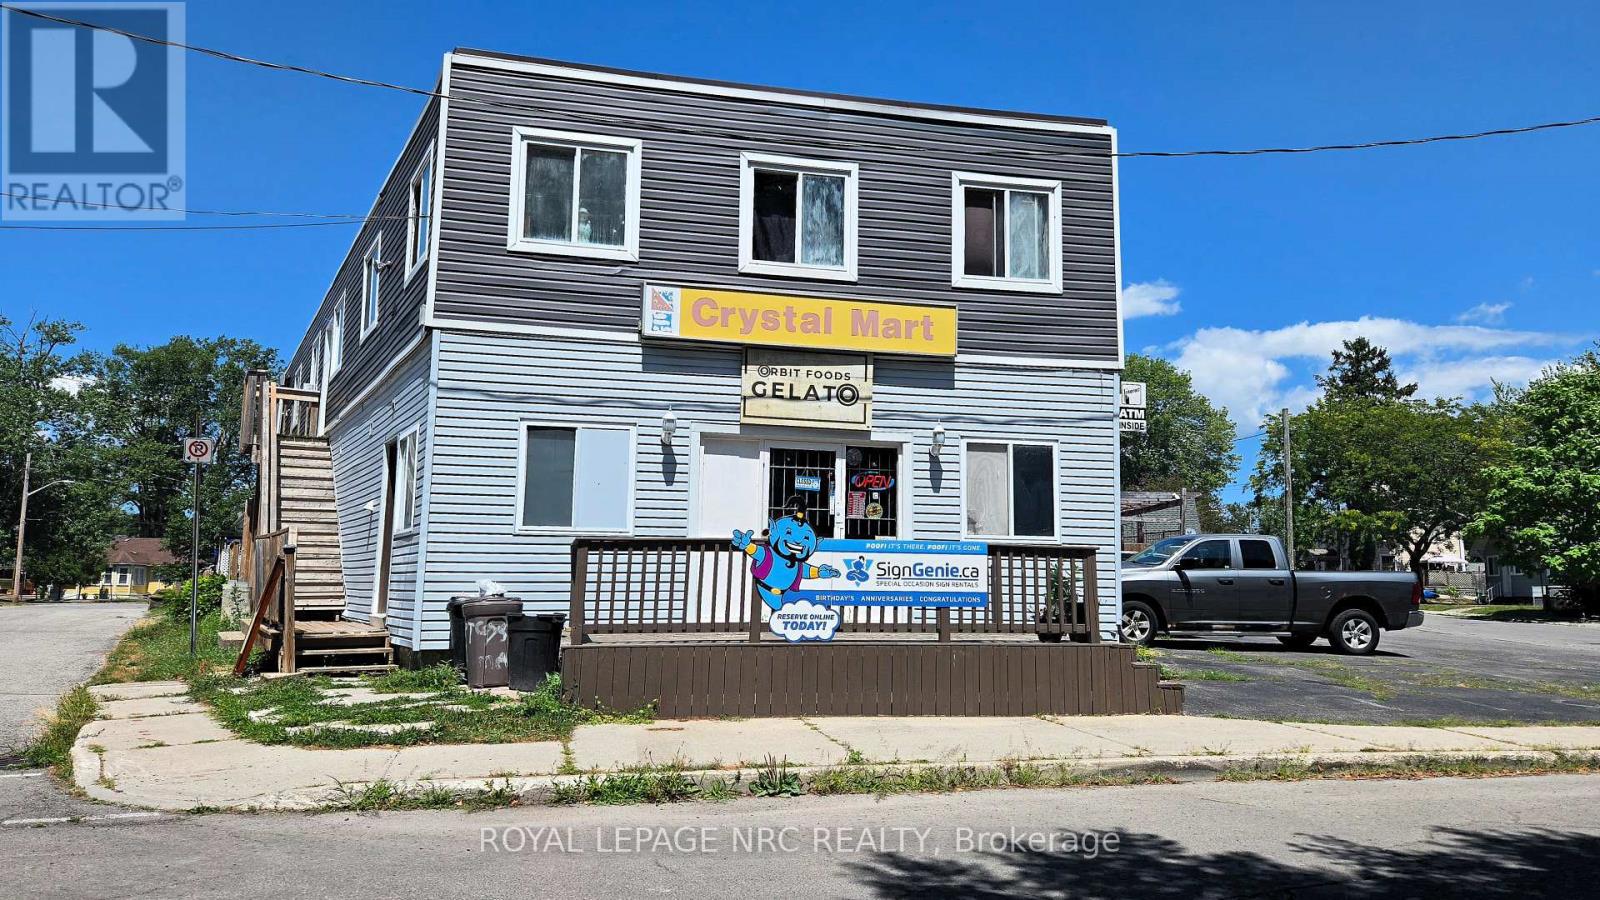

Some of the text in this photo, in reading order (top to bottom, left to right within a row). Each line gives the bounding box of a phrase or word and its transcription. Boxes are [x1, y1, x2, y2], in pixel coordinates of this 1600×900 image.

[691, 297, 935, 341] Crystal Mart
[758, 364, 851, 381] ORBIT FOODS
[751, 380, 860, 406] GELATO
[1119, 408, 1145, 419] ATM
[854, 474, 892, 488] OPEN
[876, 561, 979, 580] SignGenie.ca
[815, 594, 855, 602] BIRTHDAY'S
[783, 621, 827, 631] TODAY!
